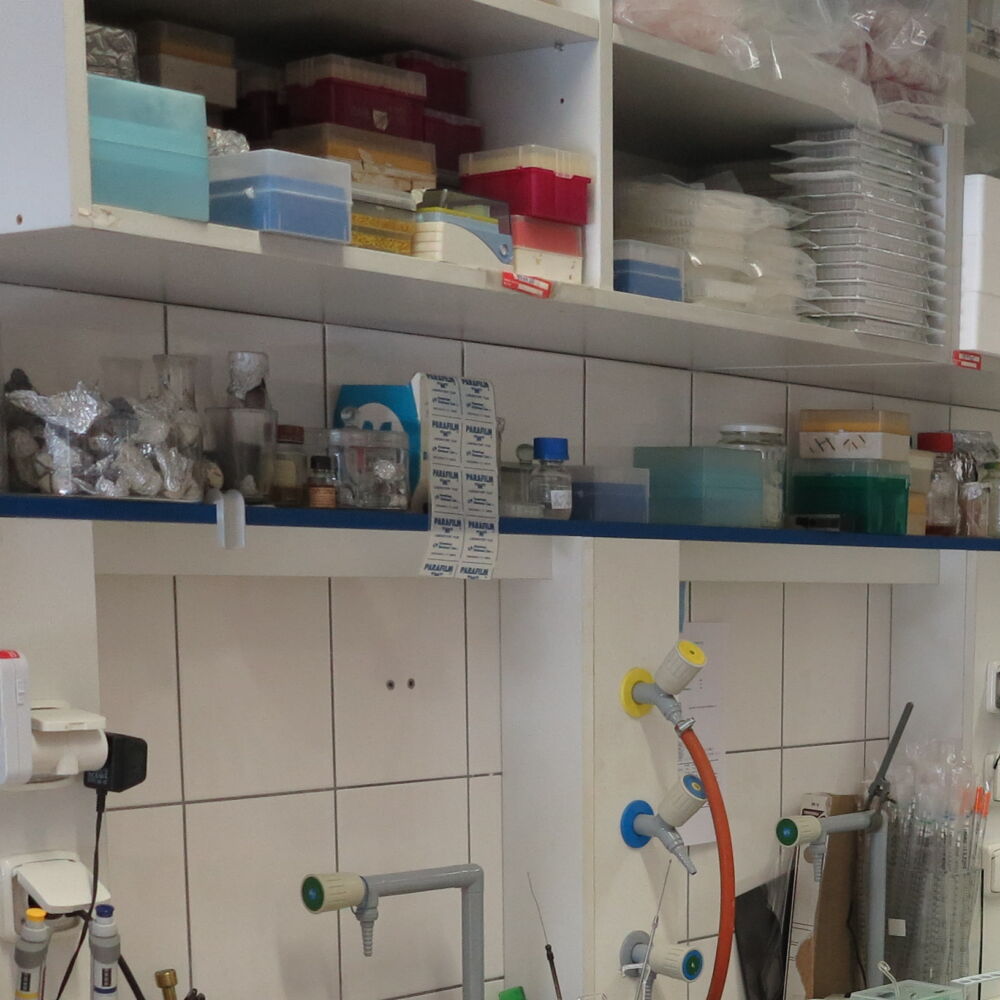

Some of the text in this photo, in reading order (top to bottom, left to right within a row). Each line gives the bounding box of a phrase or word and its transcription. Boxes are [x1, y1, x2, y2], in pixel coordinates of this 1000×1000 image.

[432, 420, 459, 431] PARAFILM
[466, 425, 493, 436] PARAFILM
[433, 469, 459, 479] PARAFILM
[466, 473, 494, 483] PARAFILM
[434, 517, 461, 528] PARAFILM
[468, 521, 495, 531] PARAFILM
[424, 563, 454, 572] PARAFILM
[460, 567, 489, 576] PARAFILM
